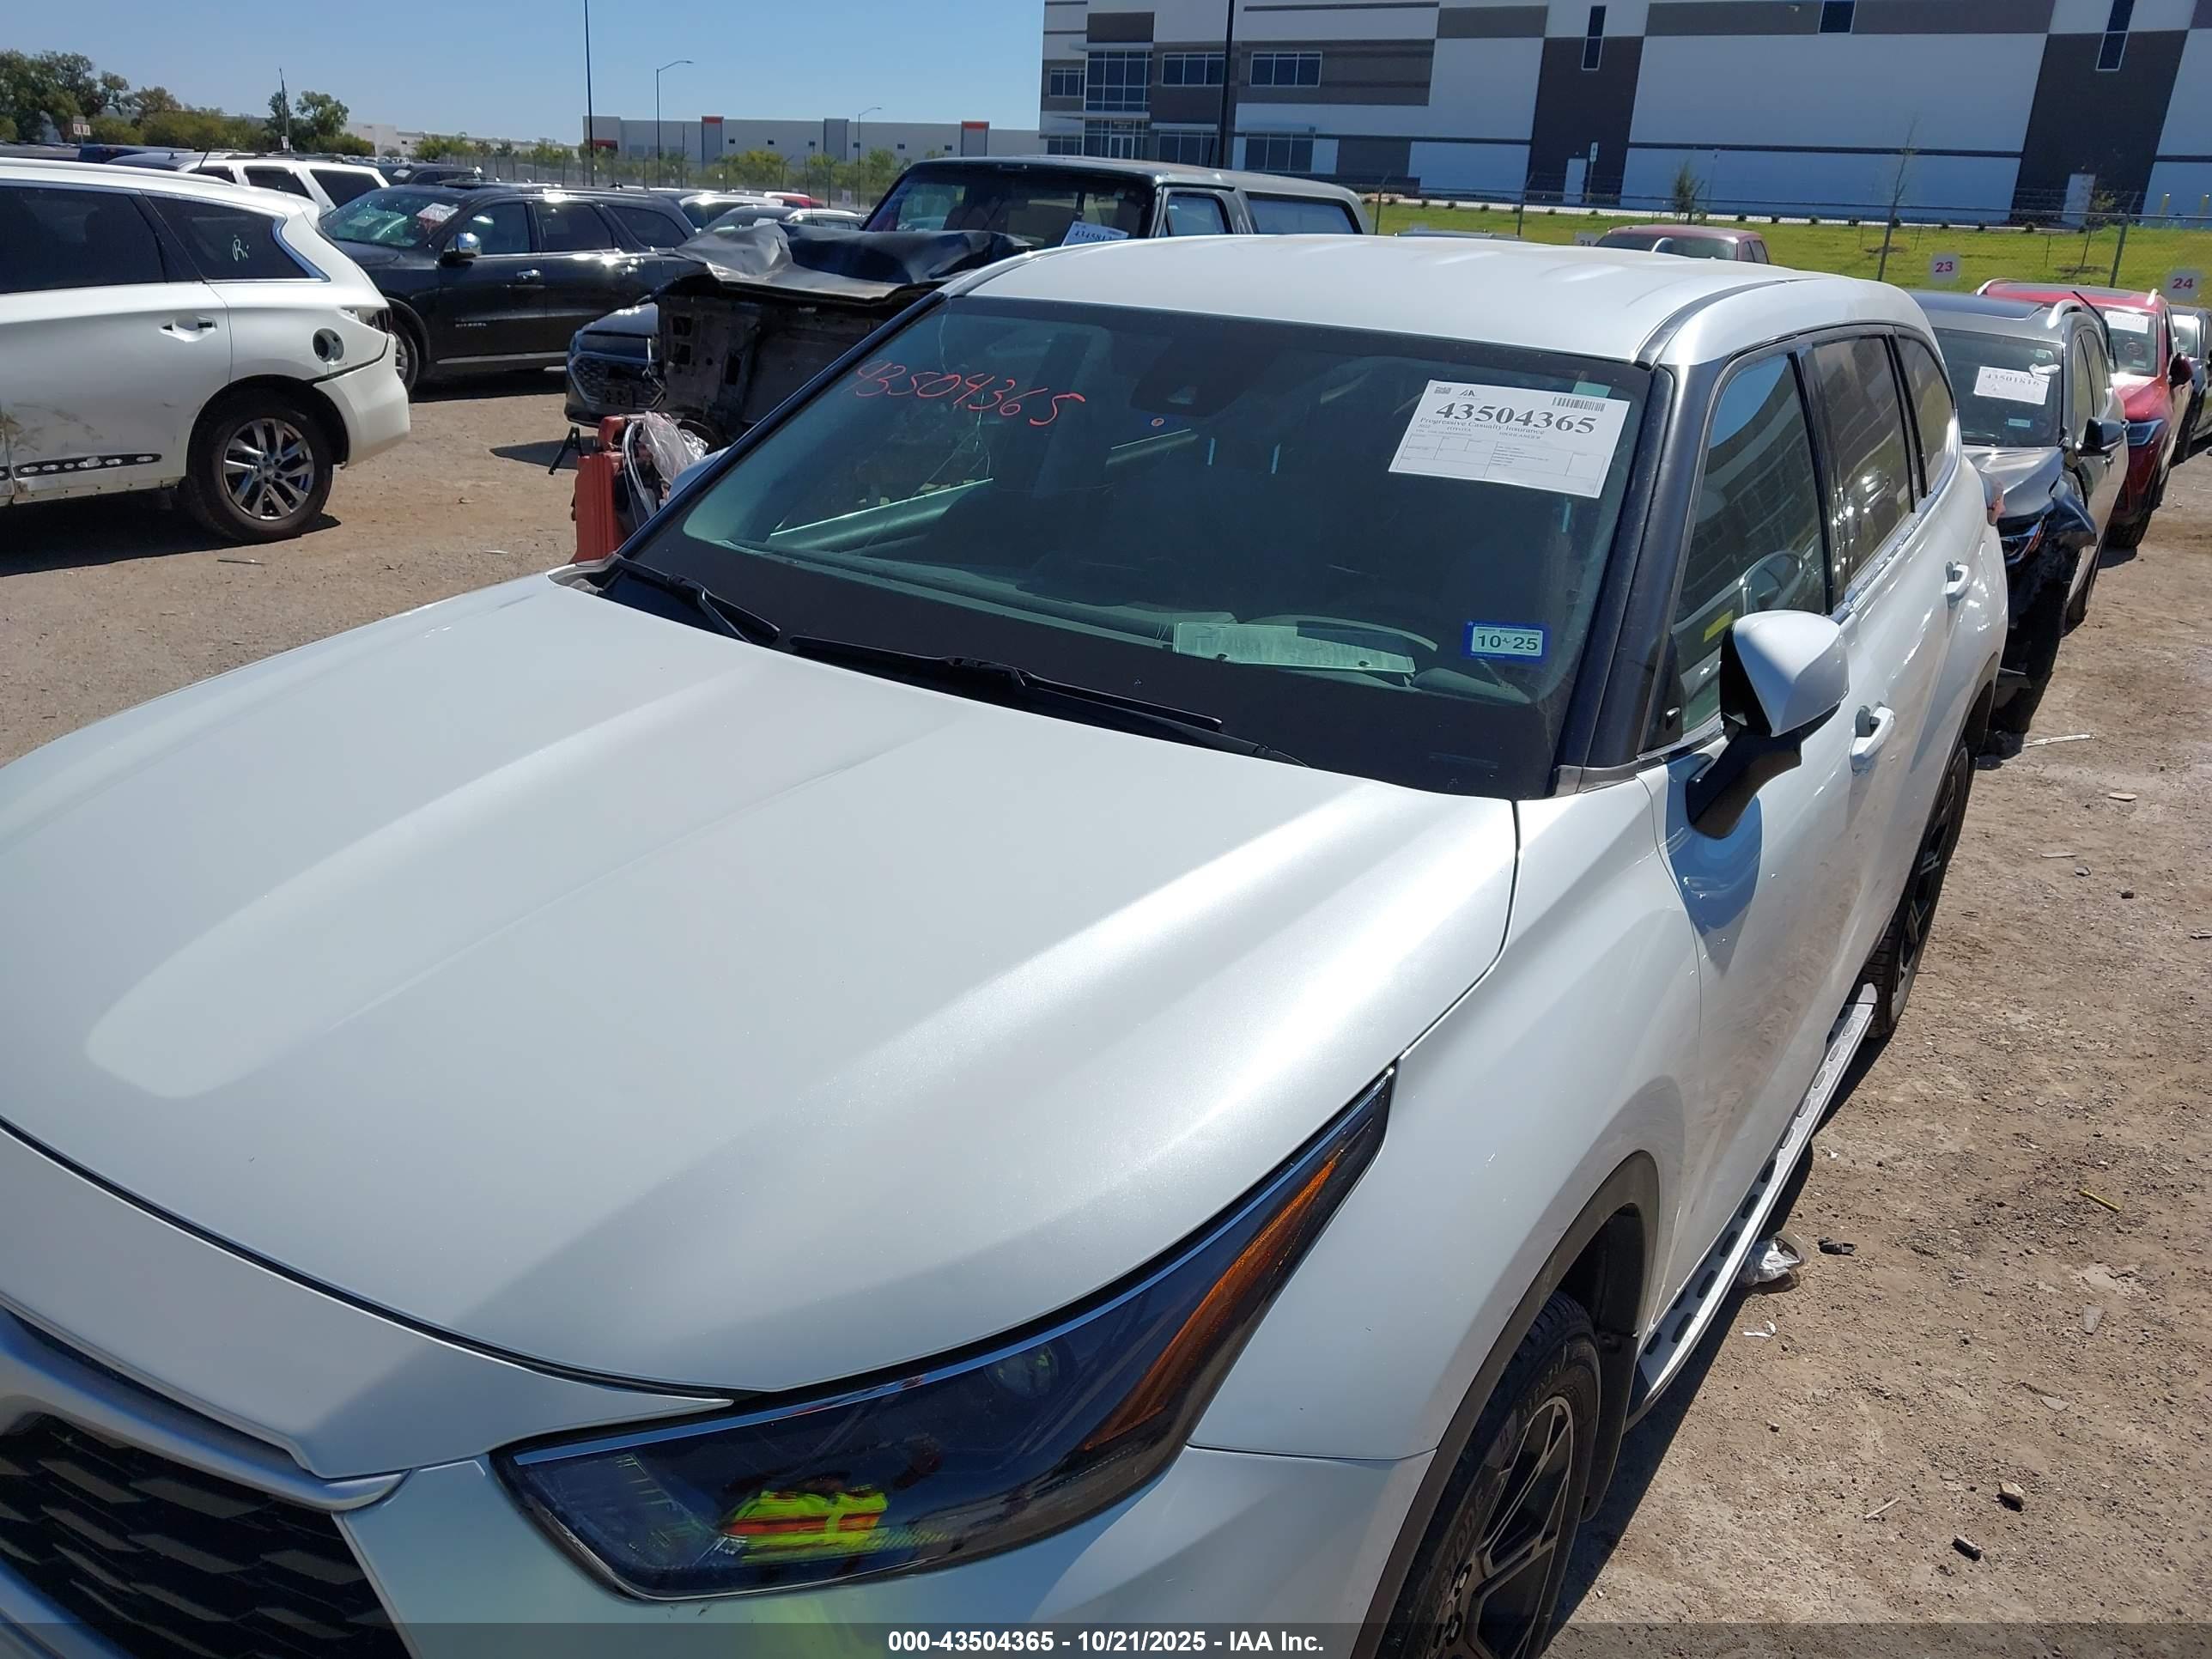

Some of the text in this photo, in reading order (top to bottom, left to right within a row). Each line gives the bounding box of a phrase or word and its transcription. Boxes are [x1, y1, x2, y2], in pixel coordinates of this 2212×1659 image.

[1935, 261, 1954, 273] 23
[2172, 277, 2194, 289] 24
[852, 360, 1085, 425] 43504365
[1419, 416, 1546, 434] Progressive Casualty Insurance
[1435, 402, 1598, 434] 43504365
